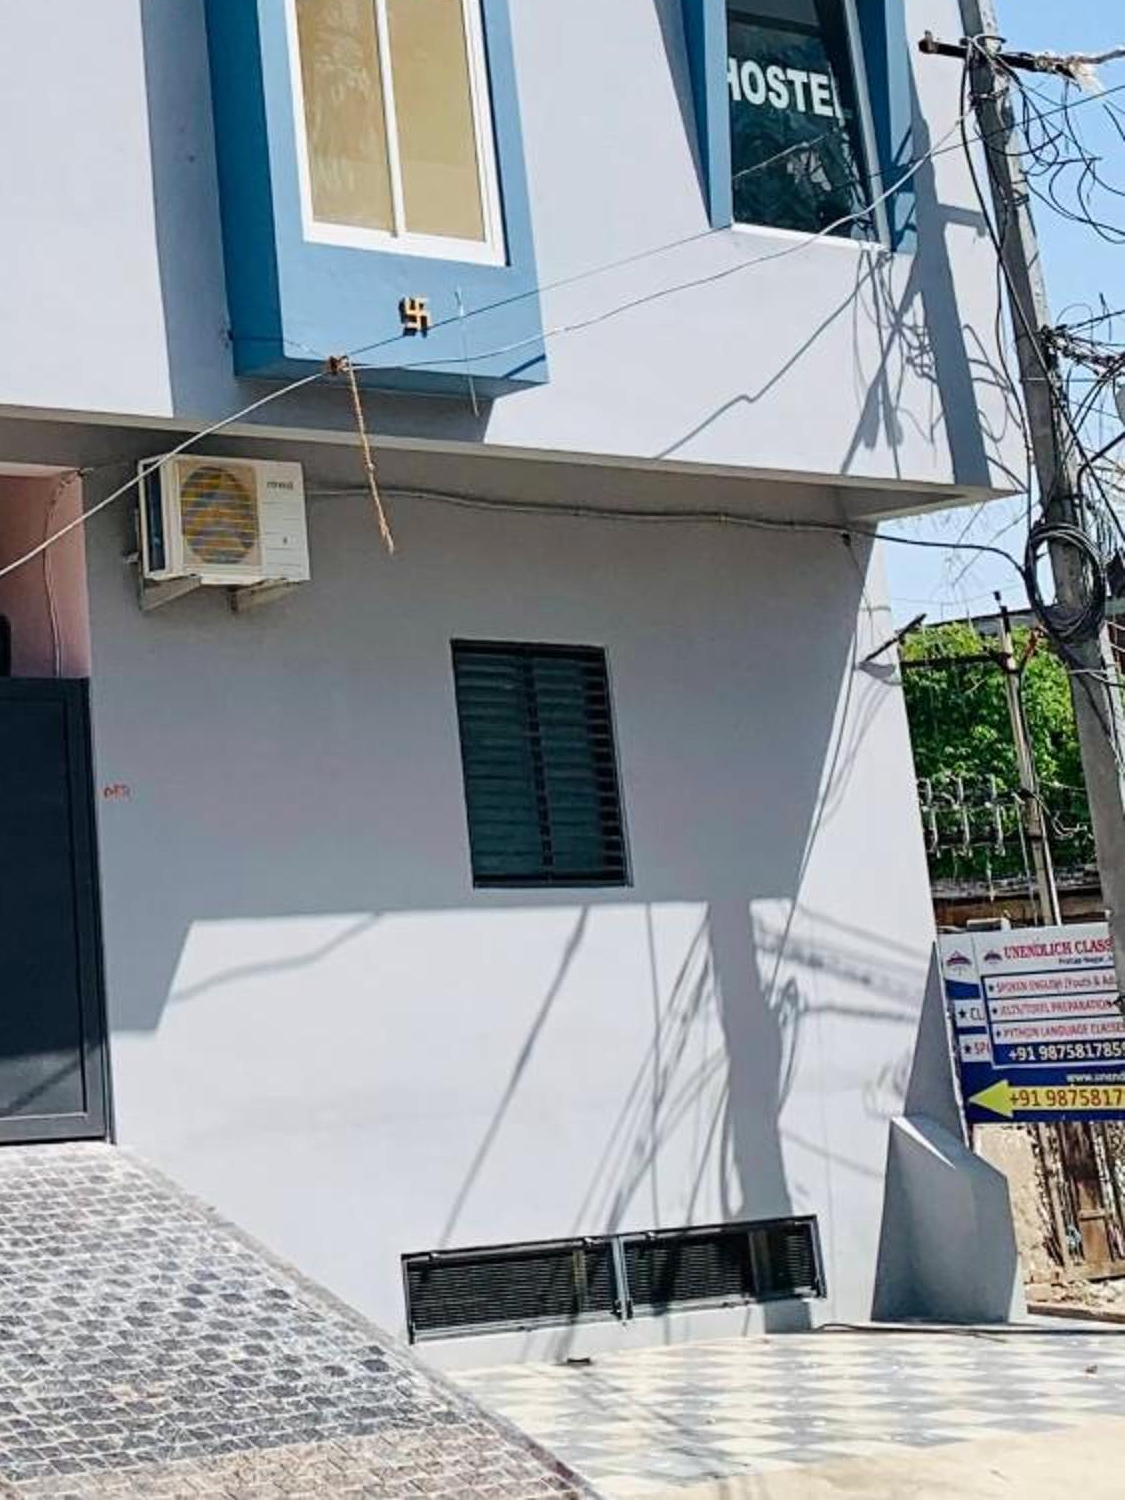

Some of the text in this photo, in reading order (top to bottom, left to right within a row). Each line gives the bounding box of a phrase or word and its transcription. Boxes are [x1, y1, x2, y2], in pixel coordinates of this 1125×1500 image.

[1003, 941, 1073, 959] UNENDLICH
[1008, 1047, 1036, 1061] +91
[1009, 1089, 1041, 1107] +91
